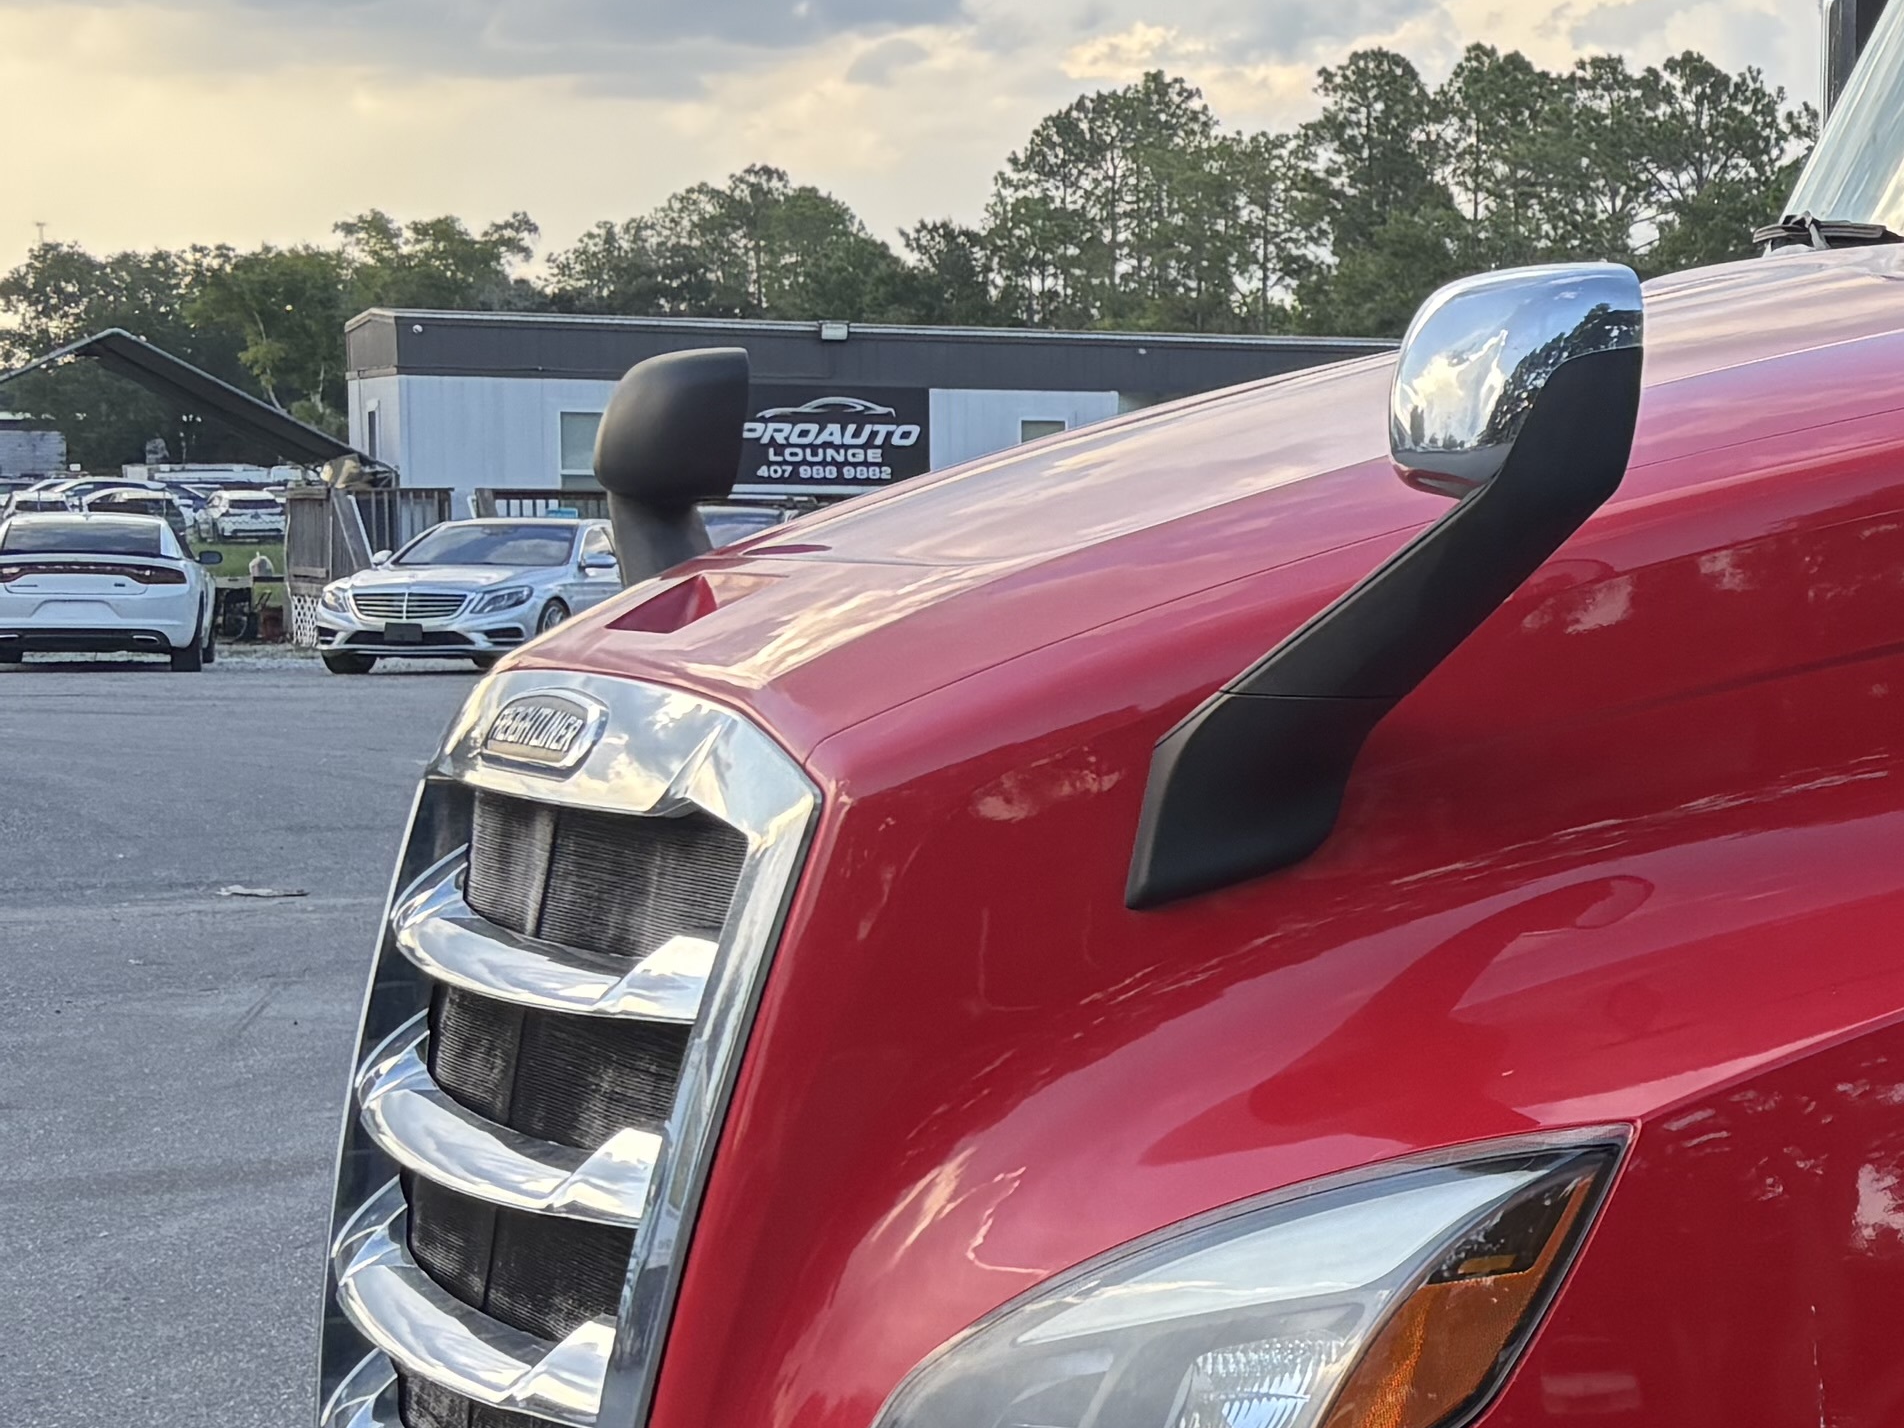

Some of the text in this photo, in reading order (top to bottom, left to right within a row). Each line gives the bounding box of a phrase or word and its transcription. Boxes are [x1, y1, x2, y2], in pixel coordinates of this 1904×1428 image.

[742, 421, 921, 447] PROAUTO
[768, 447, 883, 463] LOUNGE
[756, 465, 793, 478] 407
[490, 706, 584, 753] FREIGHTLINER
